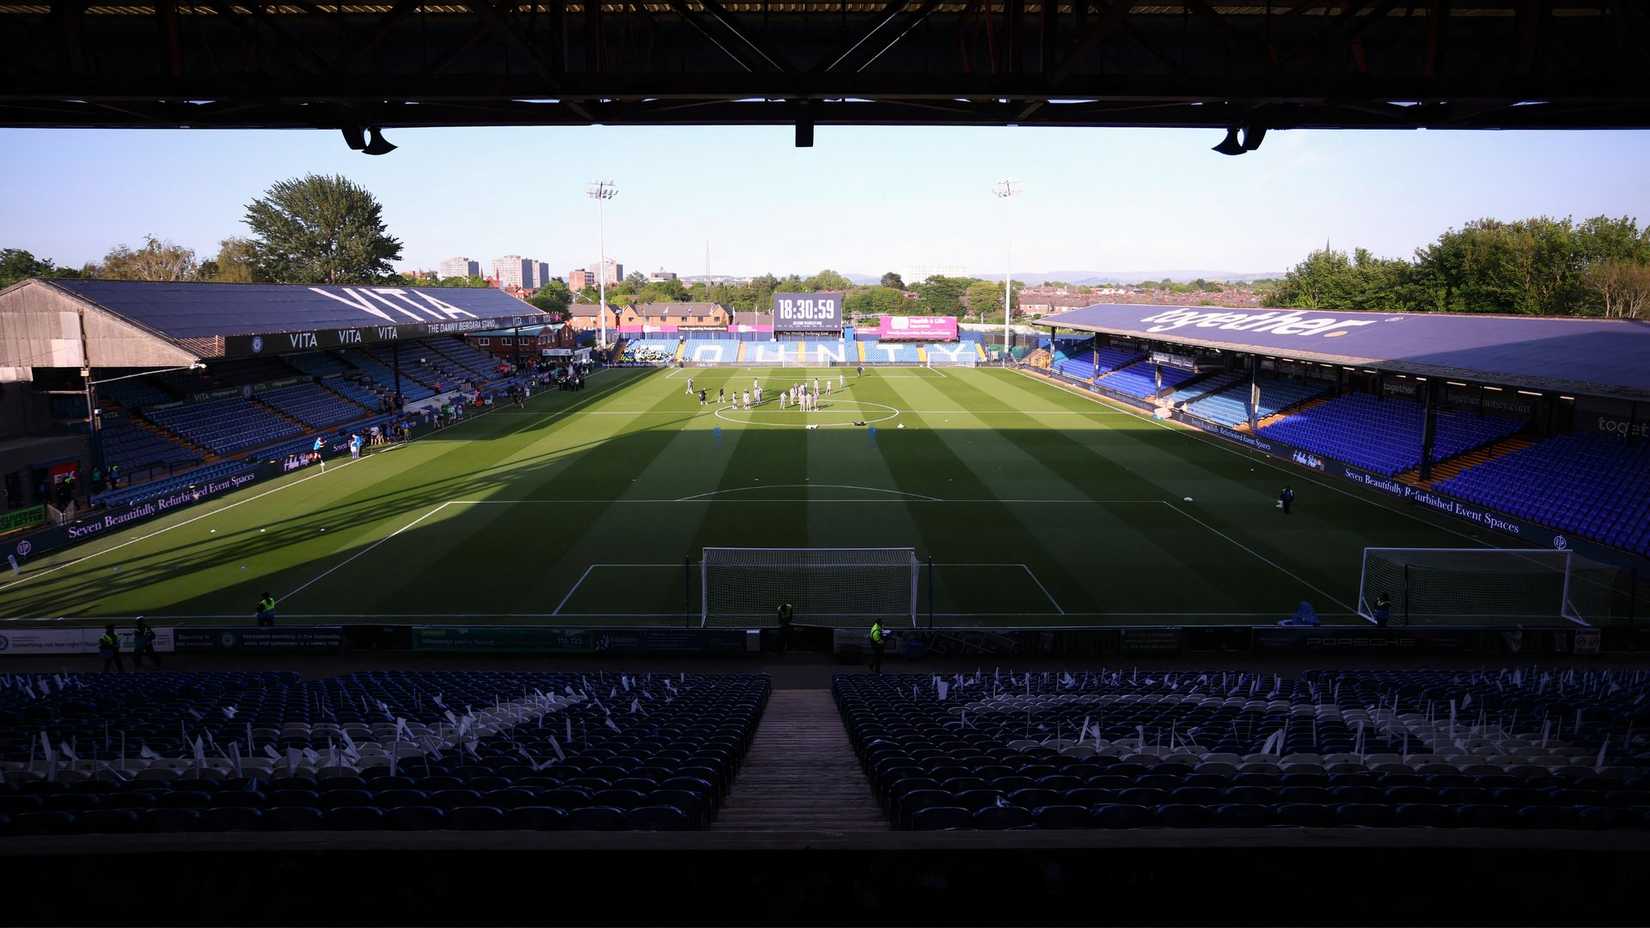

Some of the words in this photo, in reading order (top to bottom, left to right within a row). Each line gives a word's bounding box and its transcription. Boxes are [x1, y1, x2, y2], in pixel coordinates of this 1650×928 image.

[308, 287, 480, 324] VITA
[779, 299, 835, 319] 18:30:59
[290, 332, 318, 349] VITA
[338, 329, 362, 345] VITA
[378, 326, 399, 342] VITA
[427, 324, 439, 334] THE
[68, 523, 102, 539] Seven
[104, 504, 157, 529] Beautifully
[208, 477, 231, 495] Event
[231, 472, 257, 489] Spaces
[1344, 469, 1364, 484] Seven
[1365, 475, 1403, 496] Beautifully
[1455, 504, 1483, 522] Event
[1484, 513, 1520, 535] Spaces
